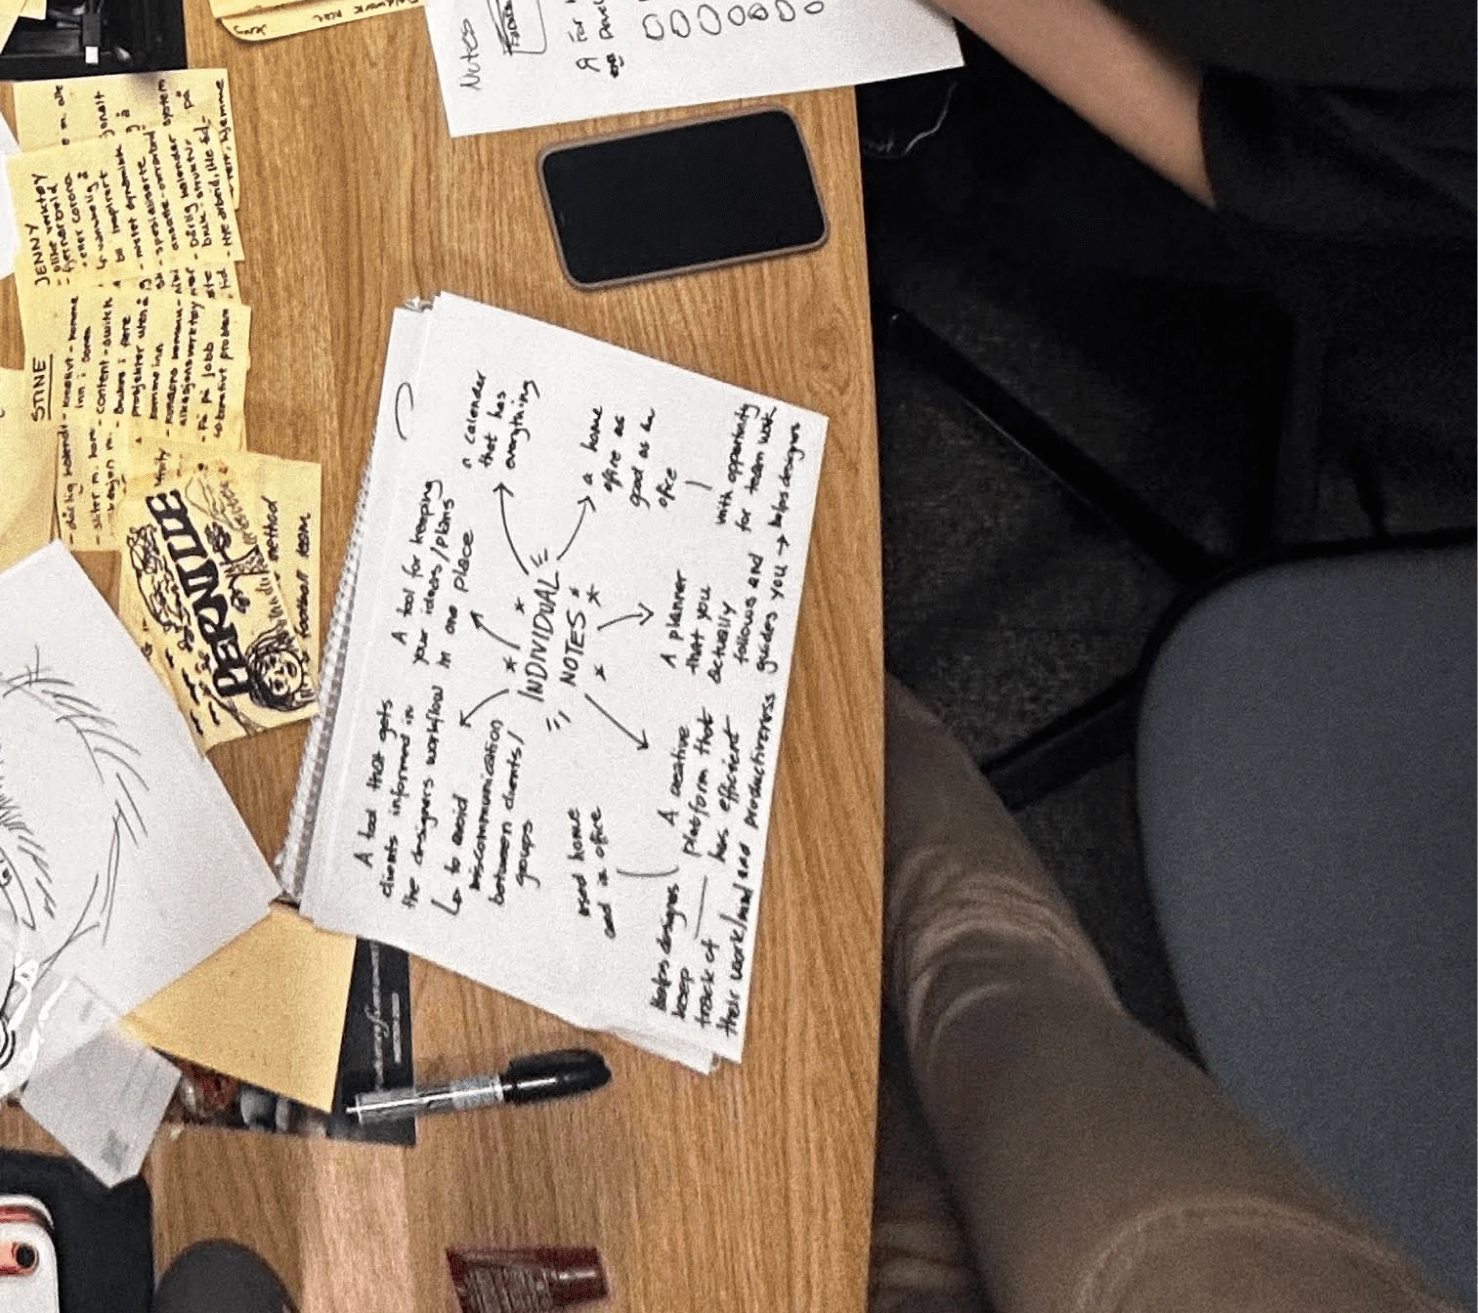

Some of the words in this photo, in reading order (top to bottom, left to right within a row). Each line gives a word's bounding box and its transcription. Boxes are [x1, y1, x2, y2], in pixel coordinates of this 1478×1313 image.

[458, 16, 482, 92] Notes
[25, 221, 51, 288] JENNY
[29, 355, 48, 424] STINE
[484, 389, 508, 421] has
[580, 471, 595, 488] a
[627, 464, 652, 512] good
[407, 477, 445, 547] keeping
[734, 506, 754, 535] for
[399, 552, 424, 580] for
[450, 527, 476, 595] place
[394, 586, 417, 619] tool
[768, 563, 790, 602] you
[443, 603, 460, 637] one
[694, 583, 714, 624] you
[389, 630, 409, 648] A
[517, 569, 563, 704] INDIVIDUAL
[559, 607, 586, 688] NOTES
[731, 594, 759, 668] follows
[658, 651, 679, 671] A
[386, 731, 412, 818] informed
[655, 807, 681, 829] A
[351, 850, 376, 871] A
[442, 854, 463, 877] to
[513, 817, 543, 890] groups
